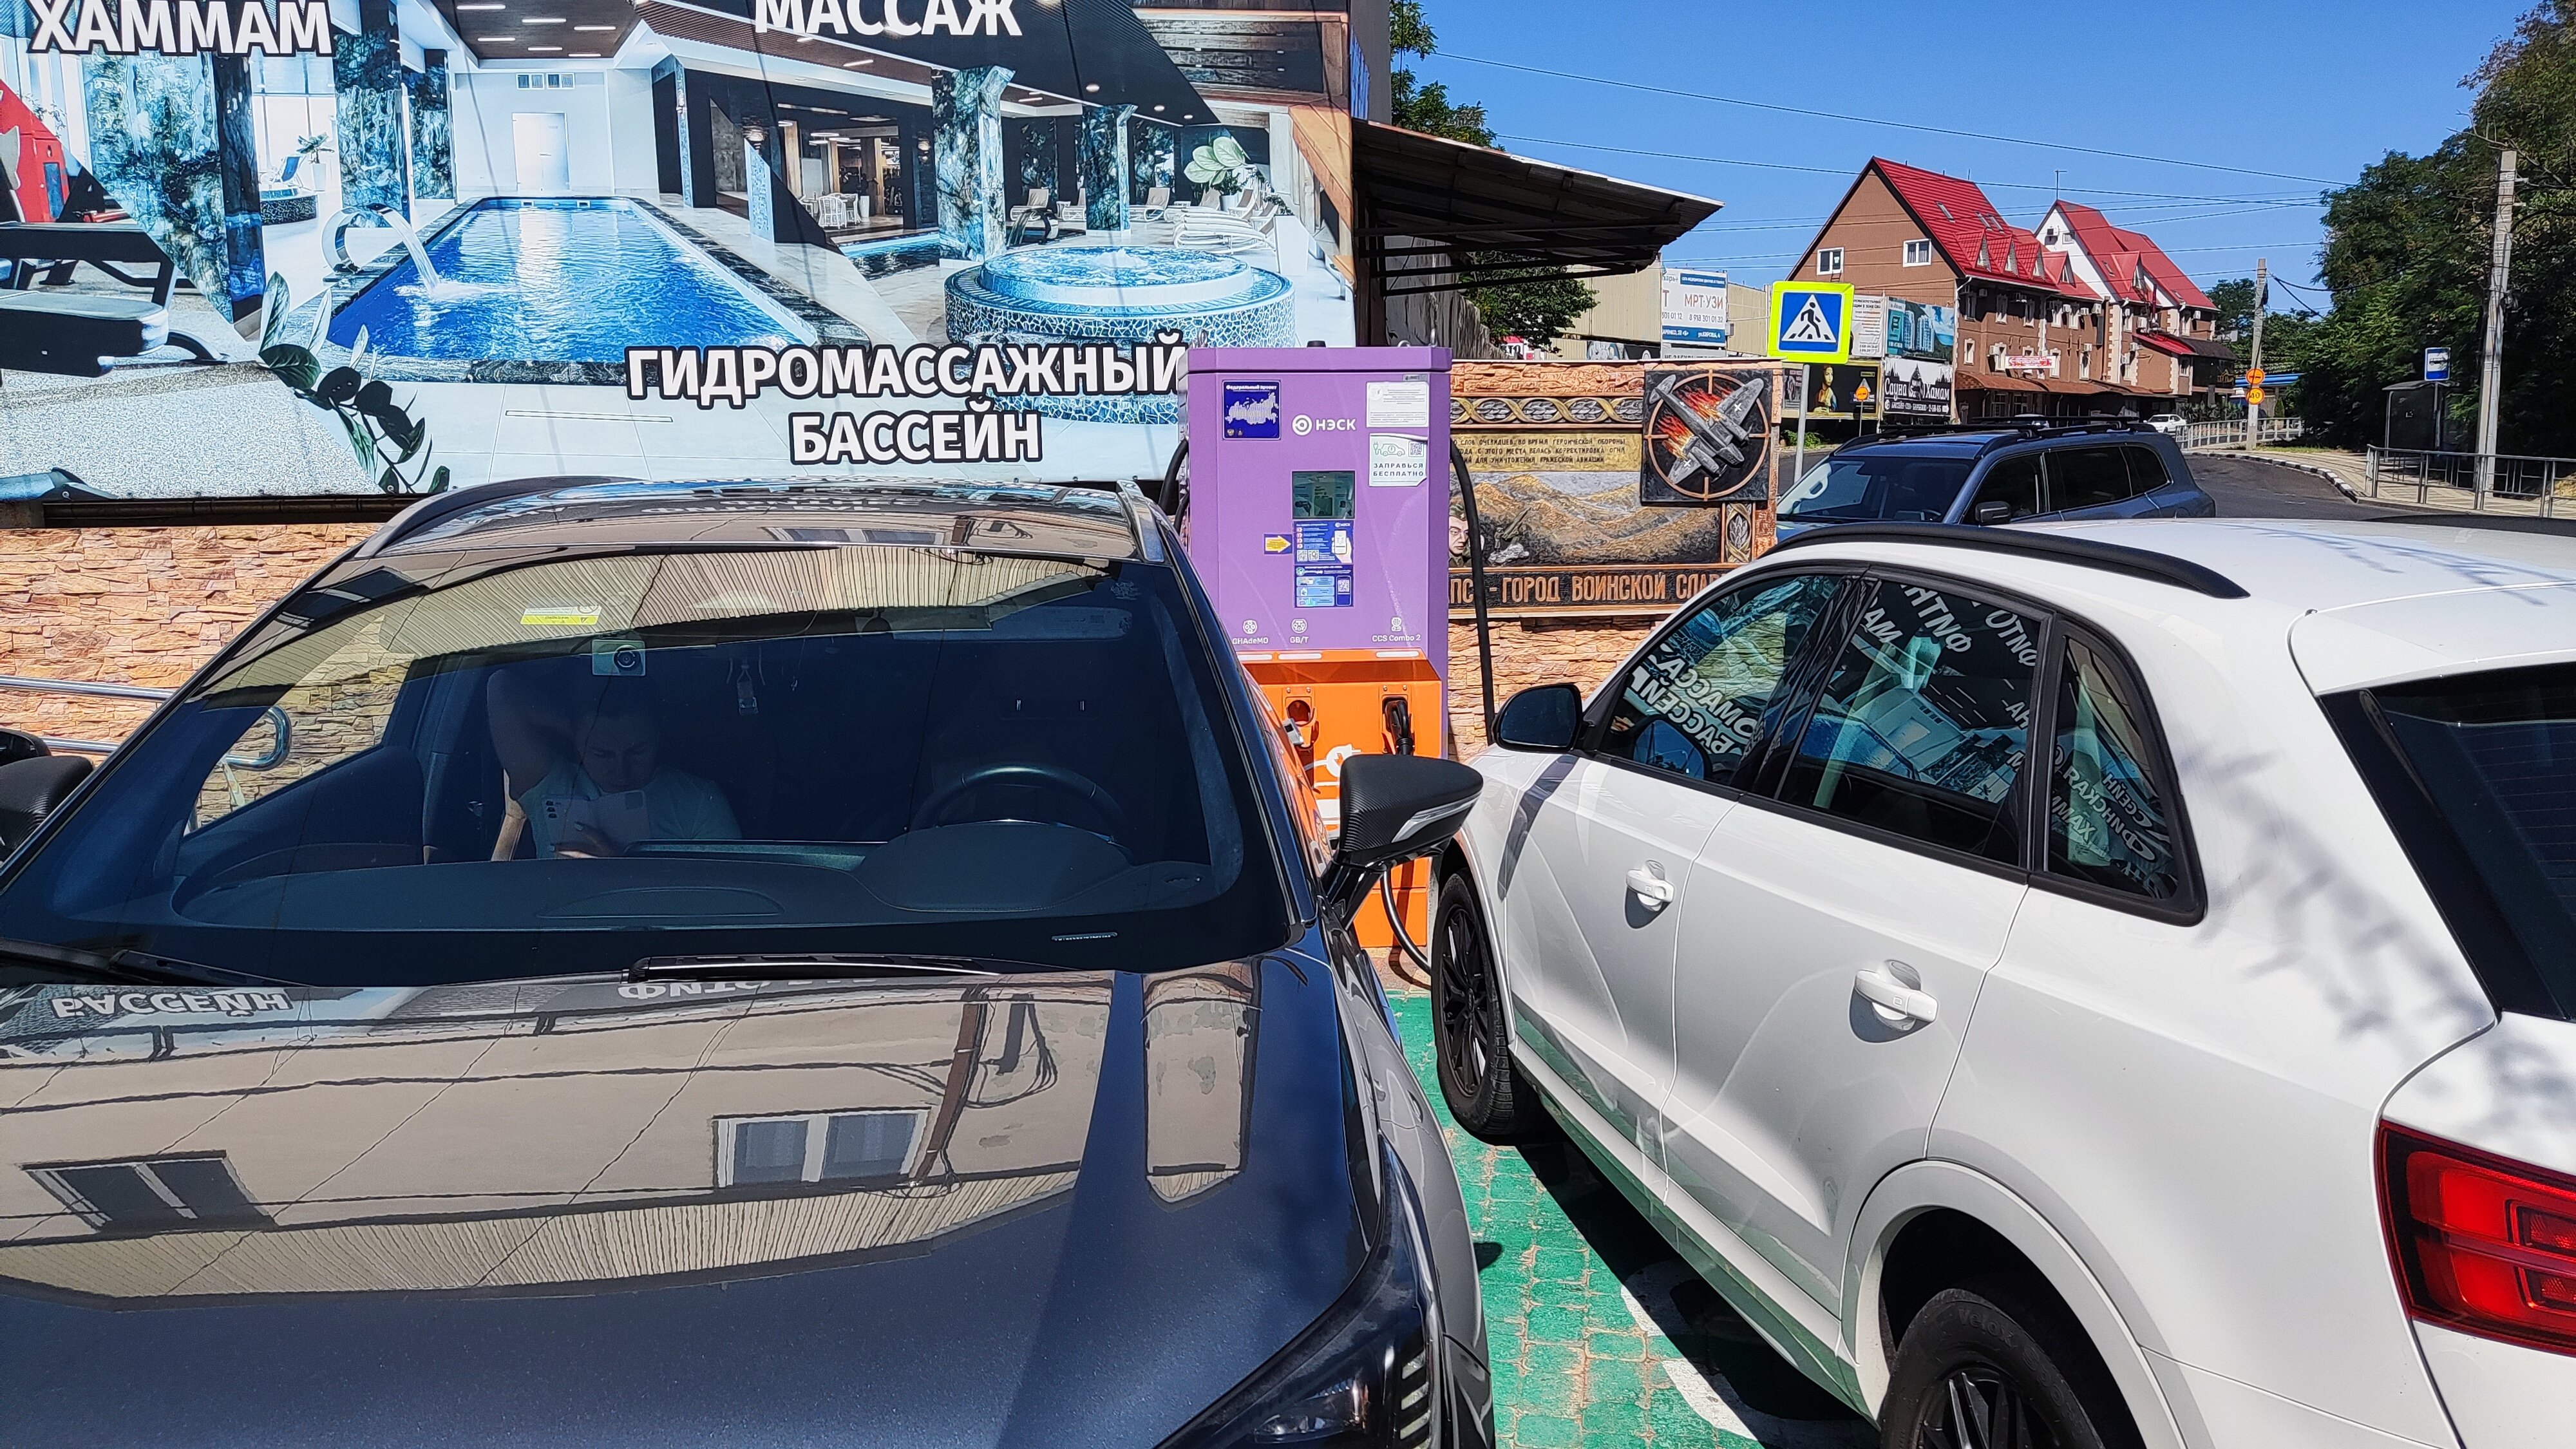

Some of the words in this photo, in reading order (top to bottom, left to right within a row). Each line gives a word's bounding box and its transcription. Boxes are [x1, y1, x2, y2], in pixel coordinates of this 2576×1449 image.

[31, 0, 334, 55] ХАММАМ
[755, 0, 1023, 37] МАССАЖ
[628, 333, 1179, 408] ГИДРОМАССАЖНЫЙ
[1884, 377, 1908, 401] Сауна
[1926, 383, 1950, 401] Хамам
[791, 401, 1041, 462] БАССЕЙН
[1316, 419, 1356, 431] НЭСК
[1501, 576, 1561, 603] ГОРОД
[1572, 571, 1665, 601] ВОИНСКОЙ
[1676, 573, 1724, 600] СЛА
[1290, 636, 1309, 645] GB/T
